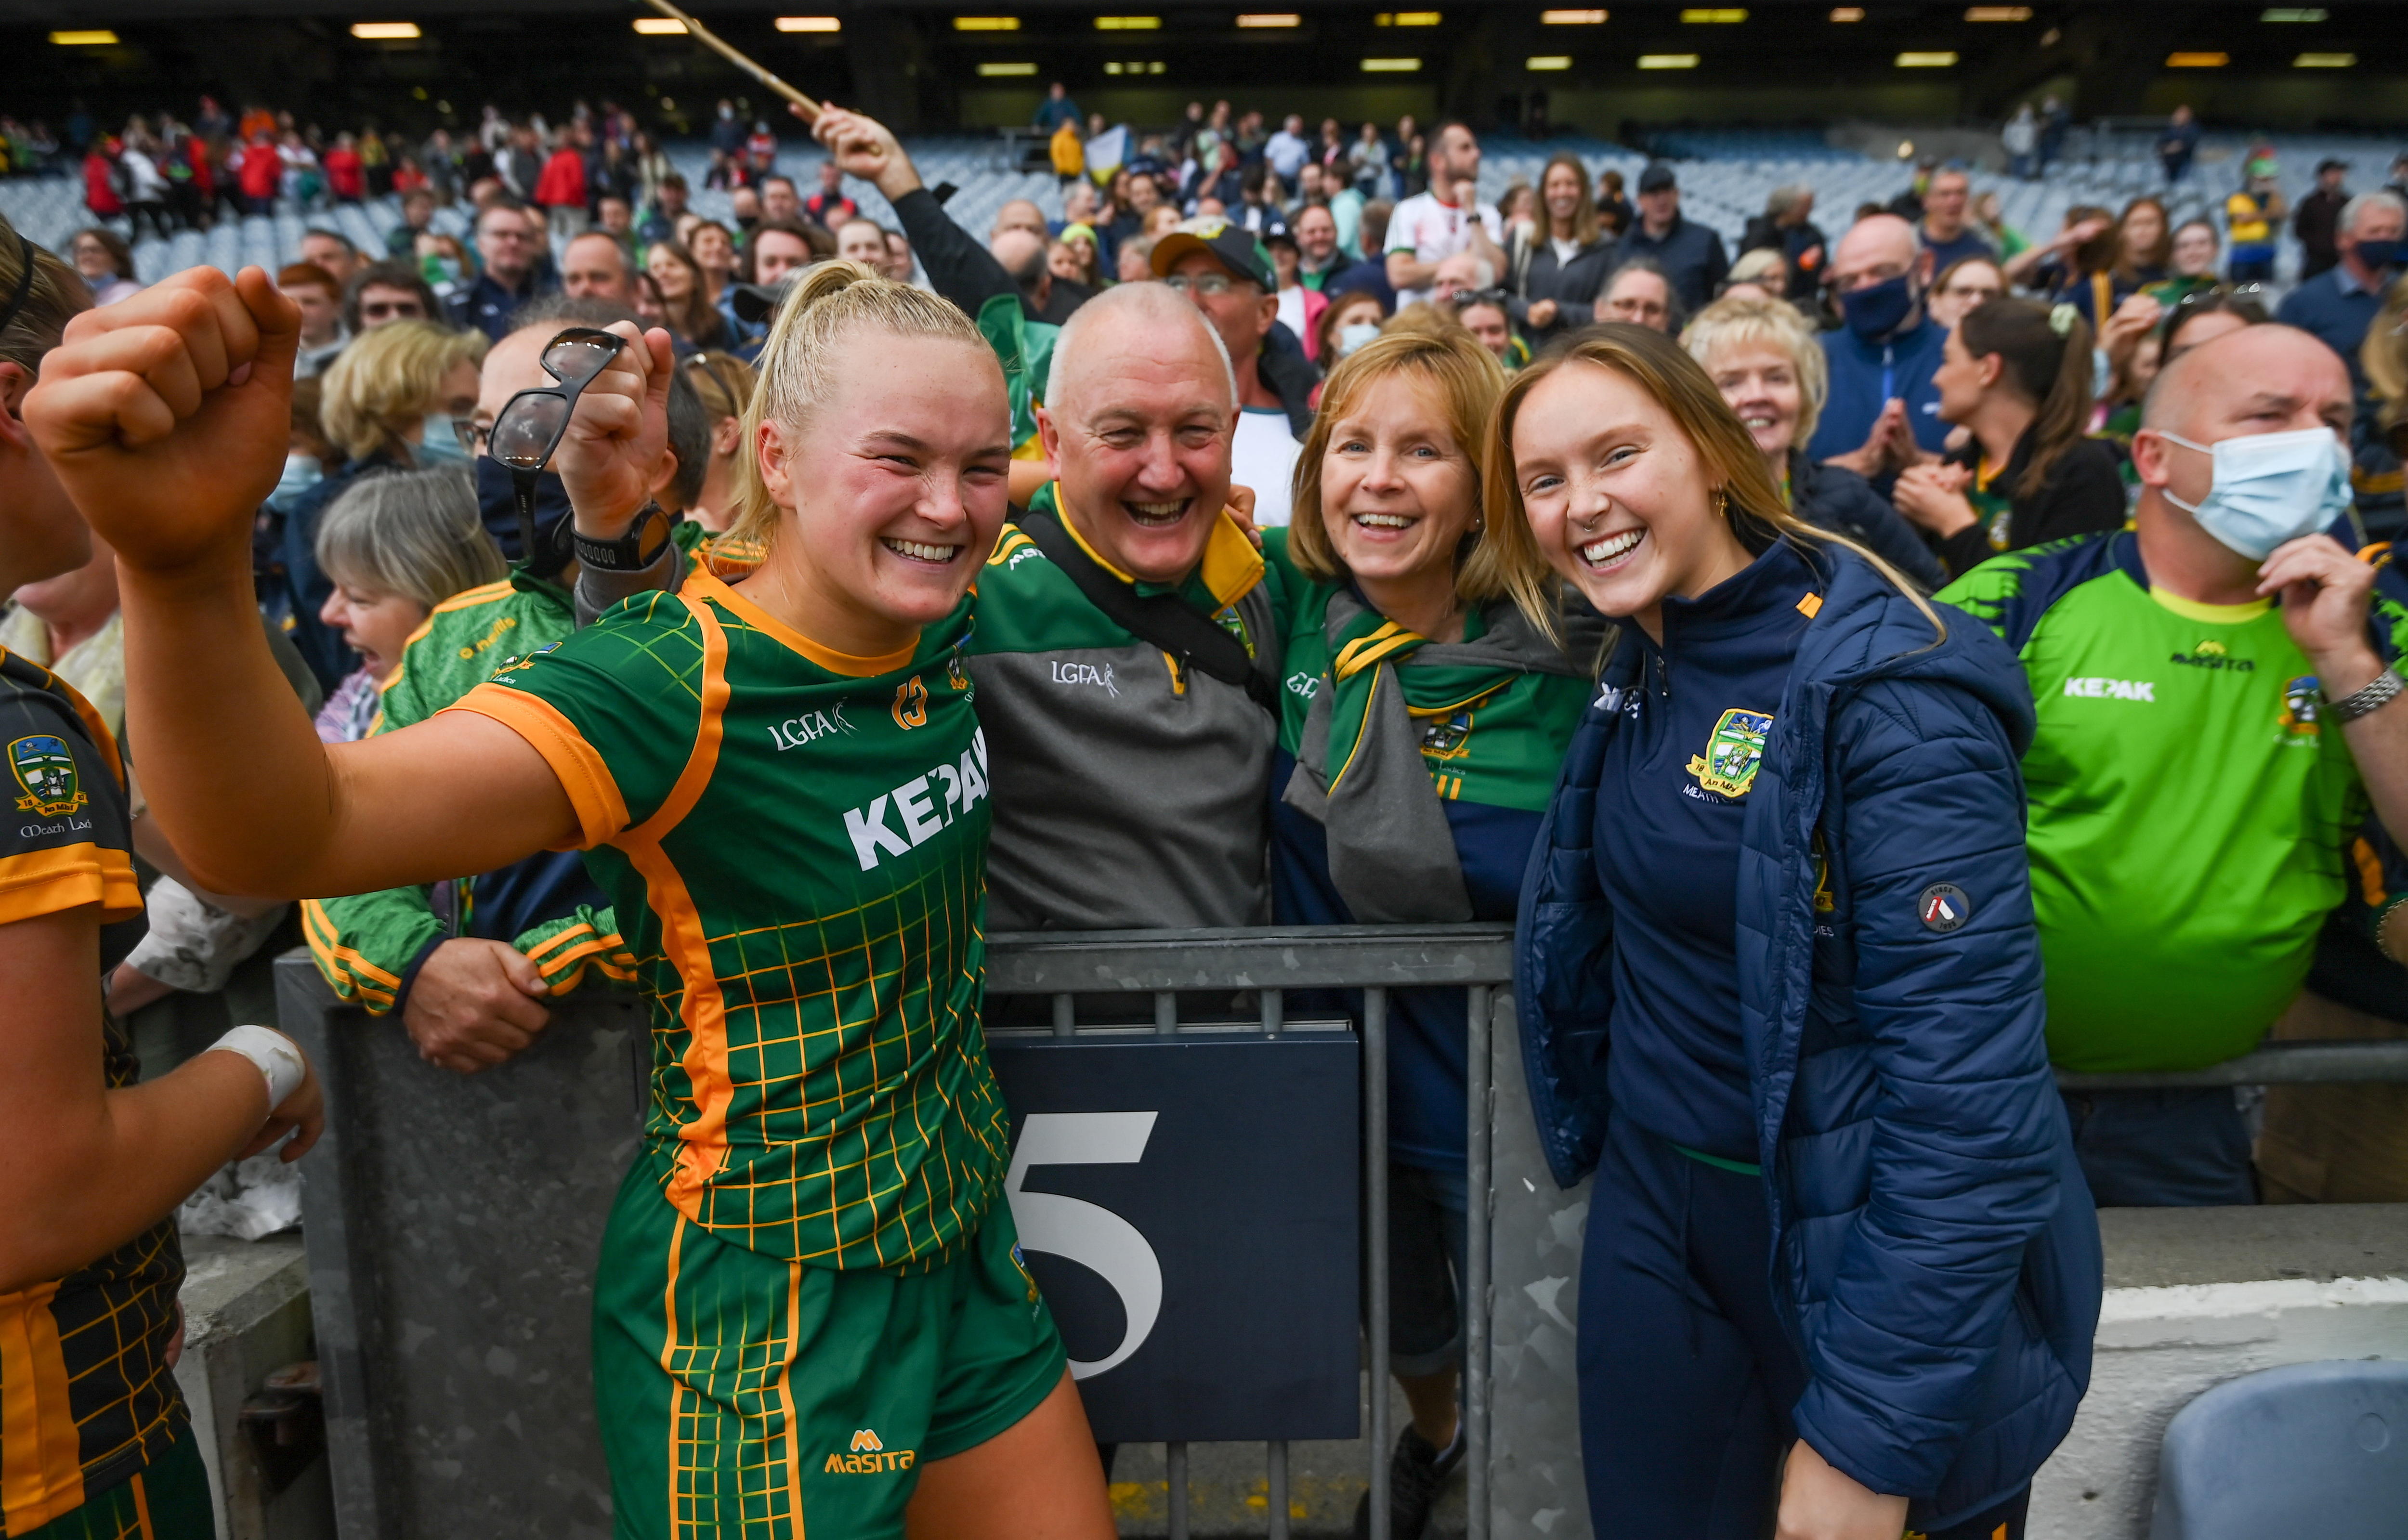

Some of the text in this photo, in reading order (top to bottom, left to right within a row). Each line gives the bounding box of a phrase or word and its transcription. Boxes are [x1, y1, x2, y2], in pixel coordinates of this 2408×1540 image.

[1051, 661, 1105, 686] LGFA
[2064, 677, 2156, 703] KEPAK
[891, 675, 929, 731] 13
[767, 709, 838, 751] LGFA
[1694, 764, 1705, 772] 18
[1683, 783, 1719, 804] MEATH
[67, 817, 92, 831] Lad
[1004, 1110, 1164, 1381] 5
